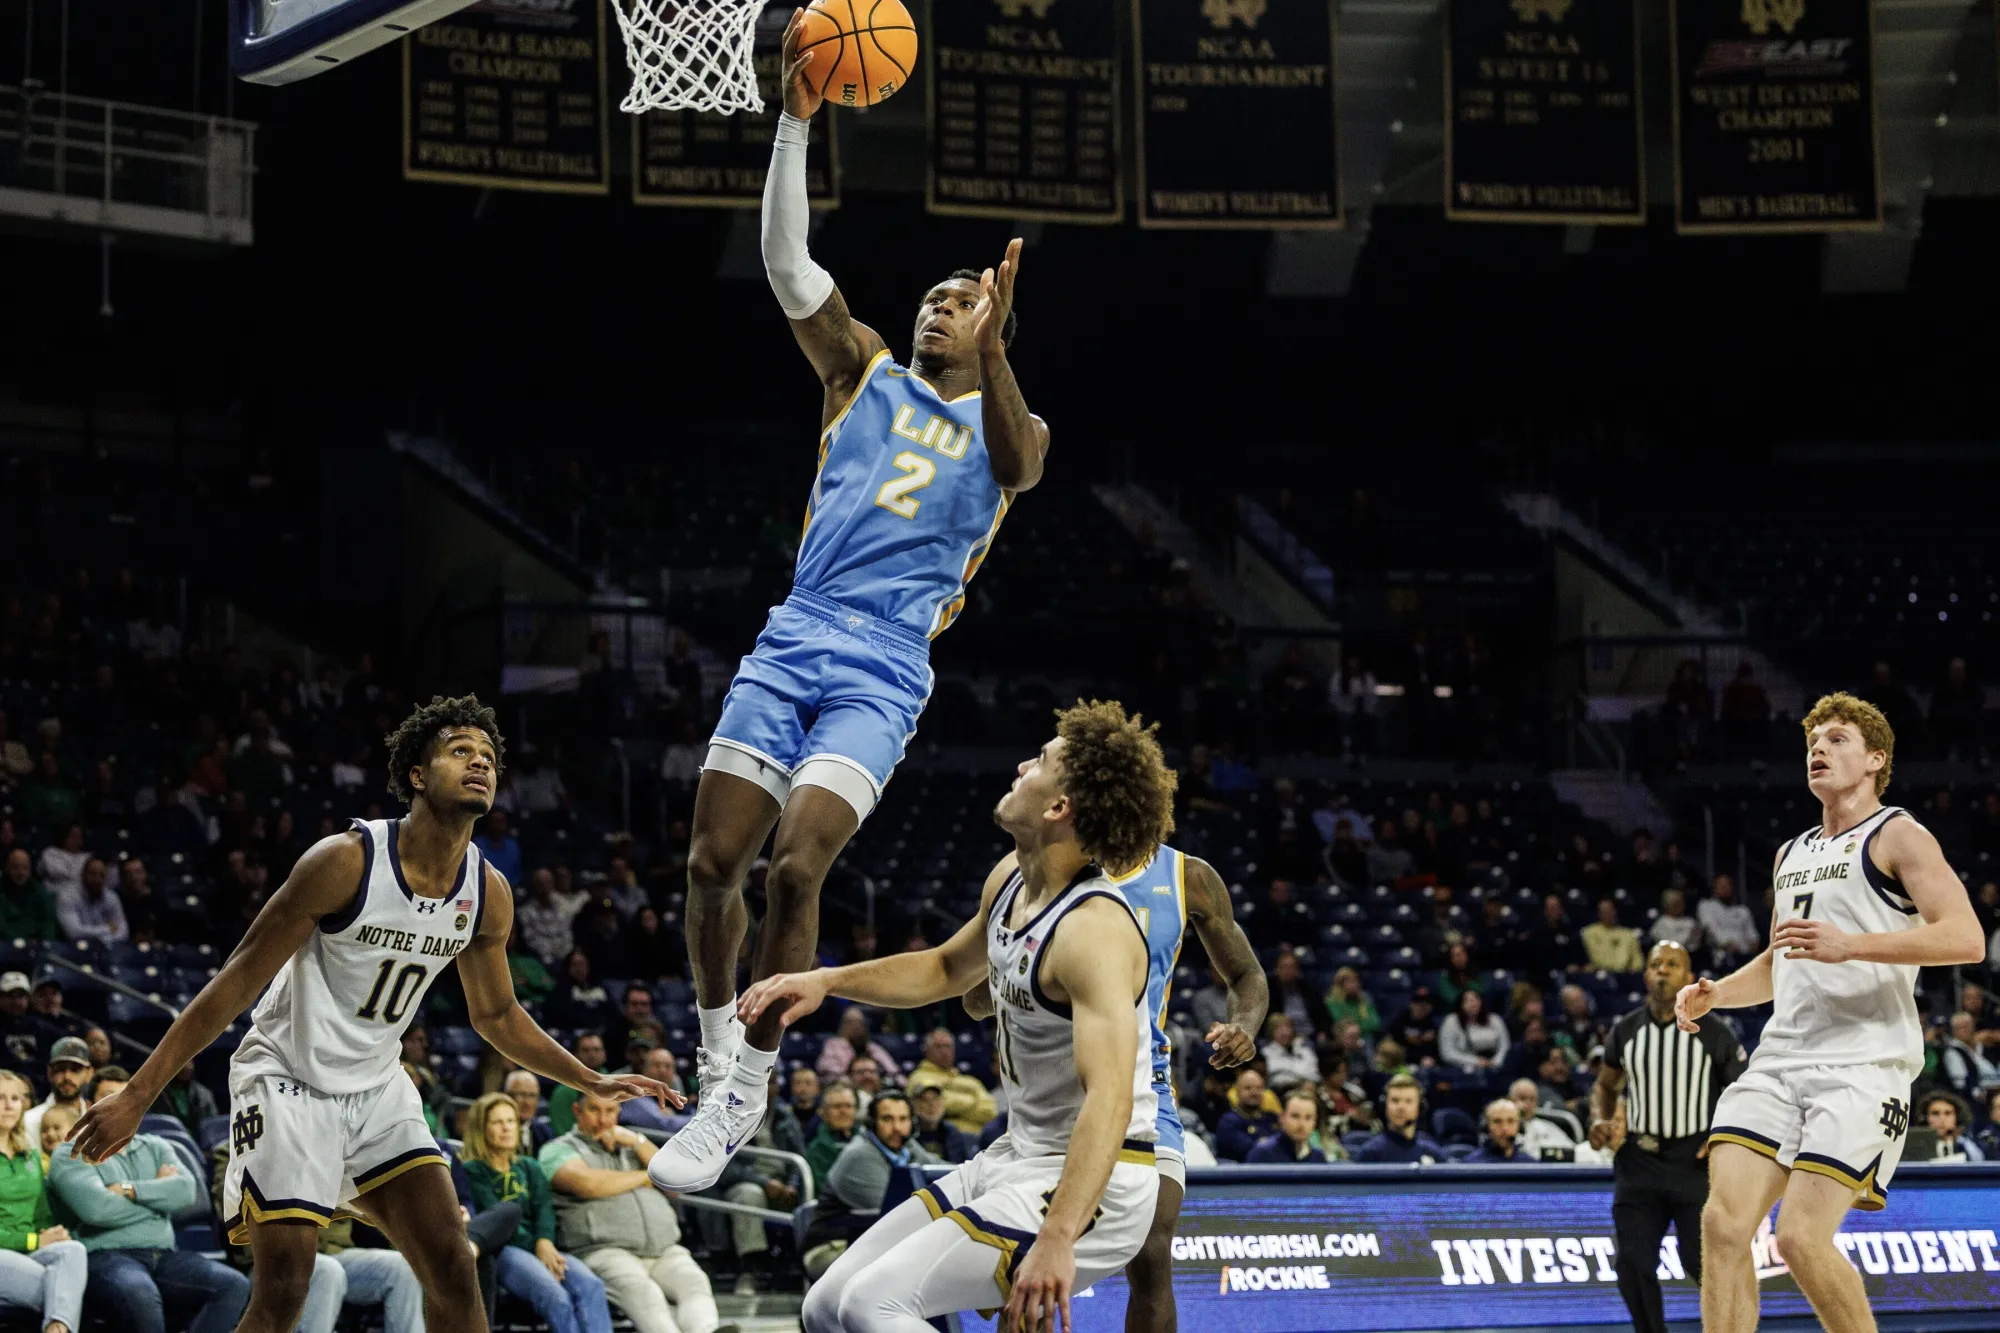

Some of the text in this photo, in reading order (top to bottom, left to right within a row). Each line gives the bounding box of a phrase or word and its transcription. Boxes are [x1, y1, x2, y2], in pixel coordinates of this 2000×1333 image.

[1197, 36, 1276, 60] NCAA
[1503, 31, 1581, 56] NCAA
[1148, 62, 1328, 88] TOURNAMENT
[1717, 107, 1834, 132] CHAMPION
[1748, 136, 1805, 164] 2001
[891, 403, 974, 460] LIU
[875, 451, 936, 520] 2
[1813, 862, 1850, 883] DAME
[1791, 891, 1814, 946] 7
[355, 925, 465, 957] NOTRE DAME
[356, 958, 428, 1024] 10
[1000, 974, 1035, 1012] DAME
[1171, 1233, 1380, 1261] GHTINGIRISH.COM
[1430, 1236, 1618, 1286] INVEST
[1832, 1229, 2000, 1275] TUDENT
